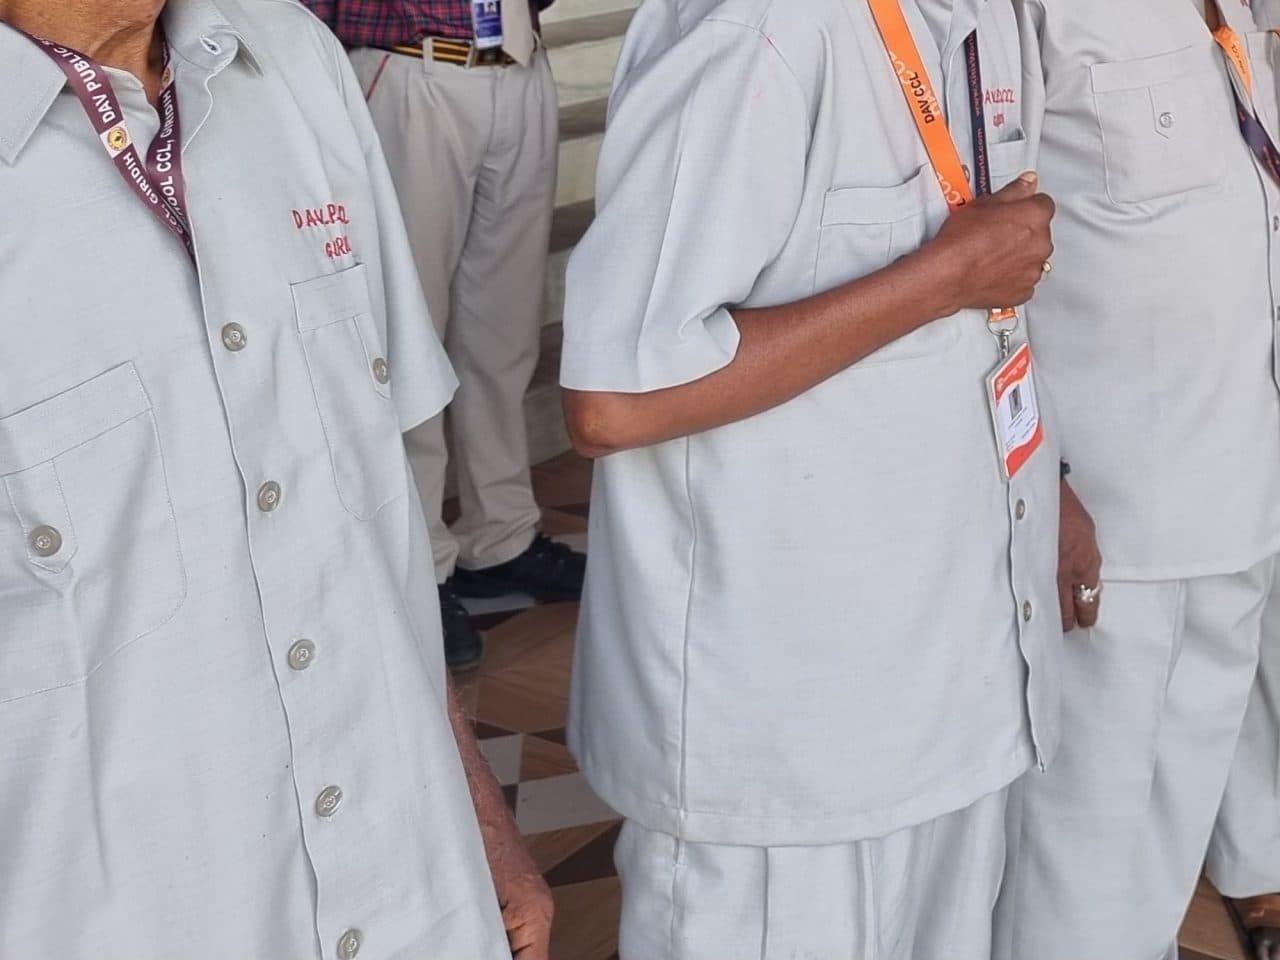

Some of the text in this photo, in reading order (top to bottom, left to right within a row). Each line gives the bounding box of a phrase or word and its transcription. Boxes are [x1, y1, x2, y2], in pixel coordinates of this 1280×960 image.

[53, 46, 102, 92] PUBLIC
[92, 93, 116, 124] DAV
[160, 91, 177, 139] GIRIDIH
[909, 72, 936, 124] DAV CCL
[123, 151, 160, 204] GIRIDIH
